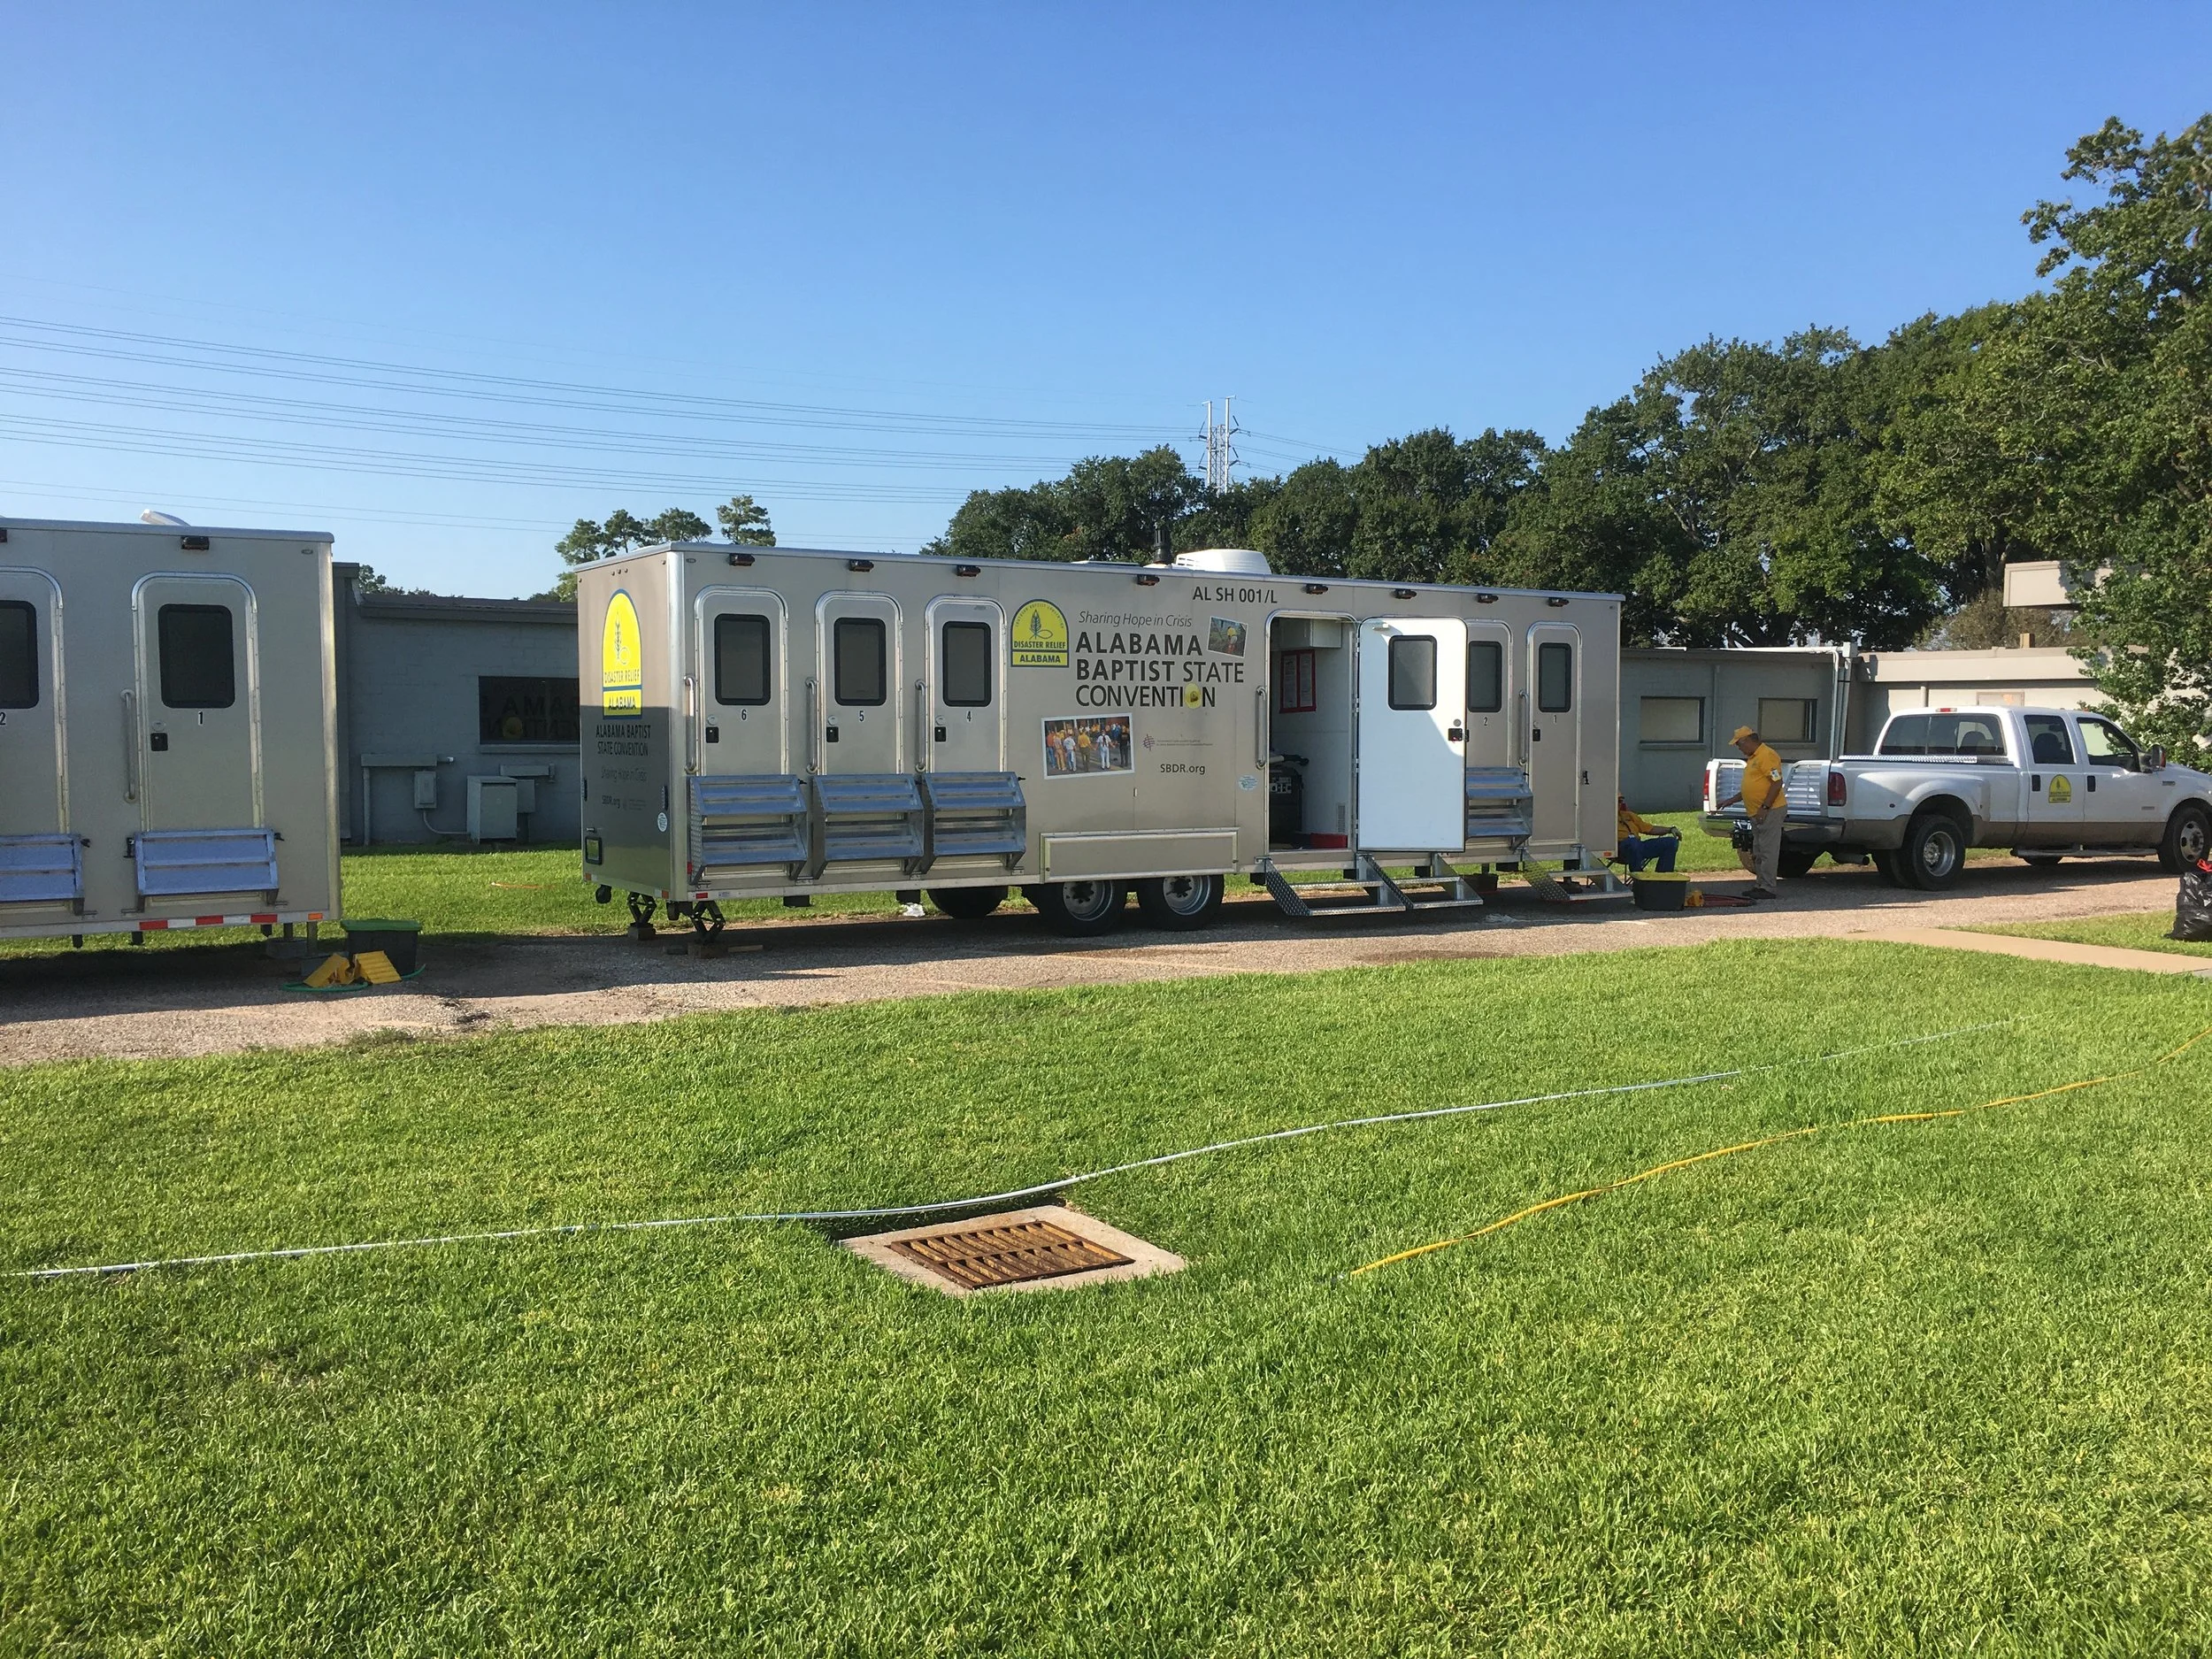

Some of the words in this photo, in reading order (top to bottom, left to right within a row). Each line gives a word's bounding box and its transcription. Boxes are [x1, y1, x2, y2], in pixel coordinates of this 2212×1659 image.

[1193, 587, 1211, 601] AL
[1216, 588, 1234, 602] SH
[1239, 588, 1278, 603] 001/L
[1079, 611, 1120, 626] Sharing
[1123, 612, 1152, 626] Hope
[1154, 613, 1164, 626] in
[1165, 614, 1192, 627] Crisis
[1076, 632, 1202, 656] ALABAMA
[604, 671, 624, 683] DISASTER
[625, 670, 640, 681] RELIEF
[1076, 659, 1175, 681] BAPTIST
[1183, 662, 1244, 683] STATE
[608, 696, 637, 710] ALABAMA
[1075, 684, 1216, 708] CONVENTIN
[0, 711, 6, 726] 2
[198, 710, 204, 725] 1
[741, 709, 747, 720] 6
[859, 710, 864, 721] 5
[966, 710, 972, 722] 4
[1483, 717, 1488, 726] 2
[595, 724, 625, 738] ALABAMA
[626, 725, 651, 739] BAPTIST
[597, 741, 613, 755] STATE
[614, 741, 649, 757] CONVENTION
[1160, 764, 1206, 775] SBDR.org
